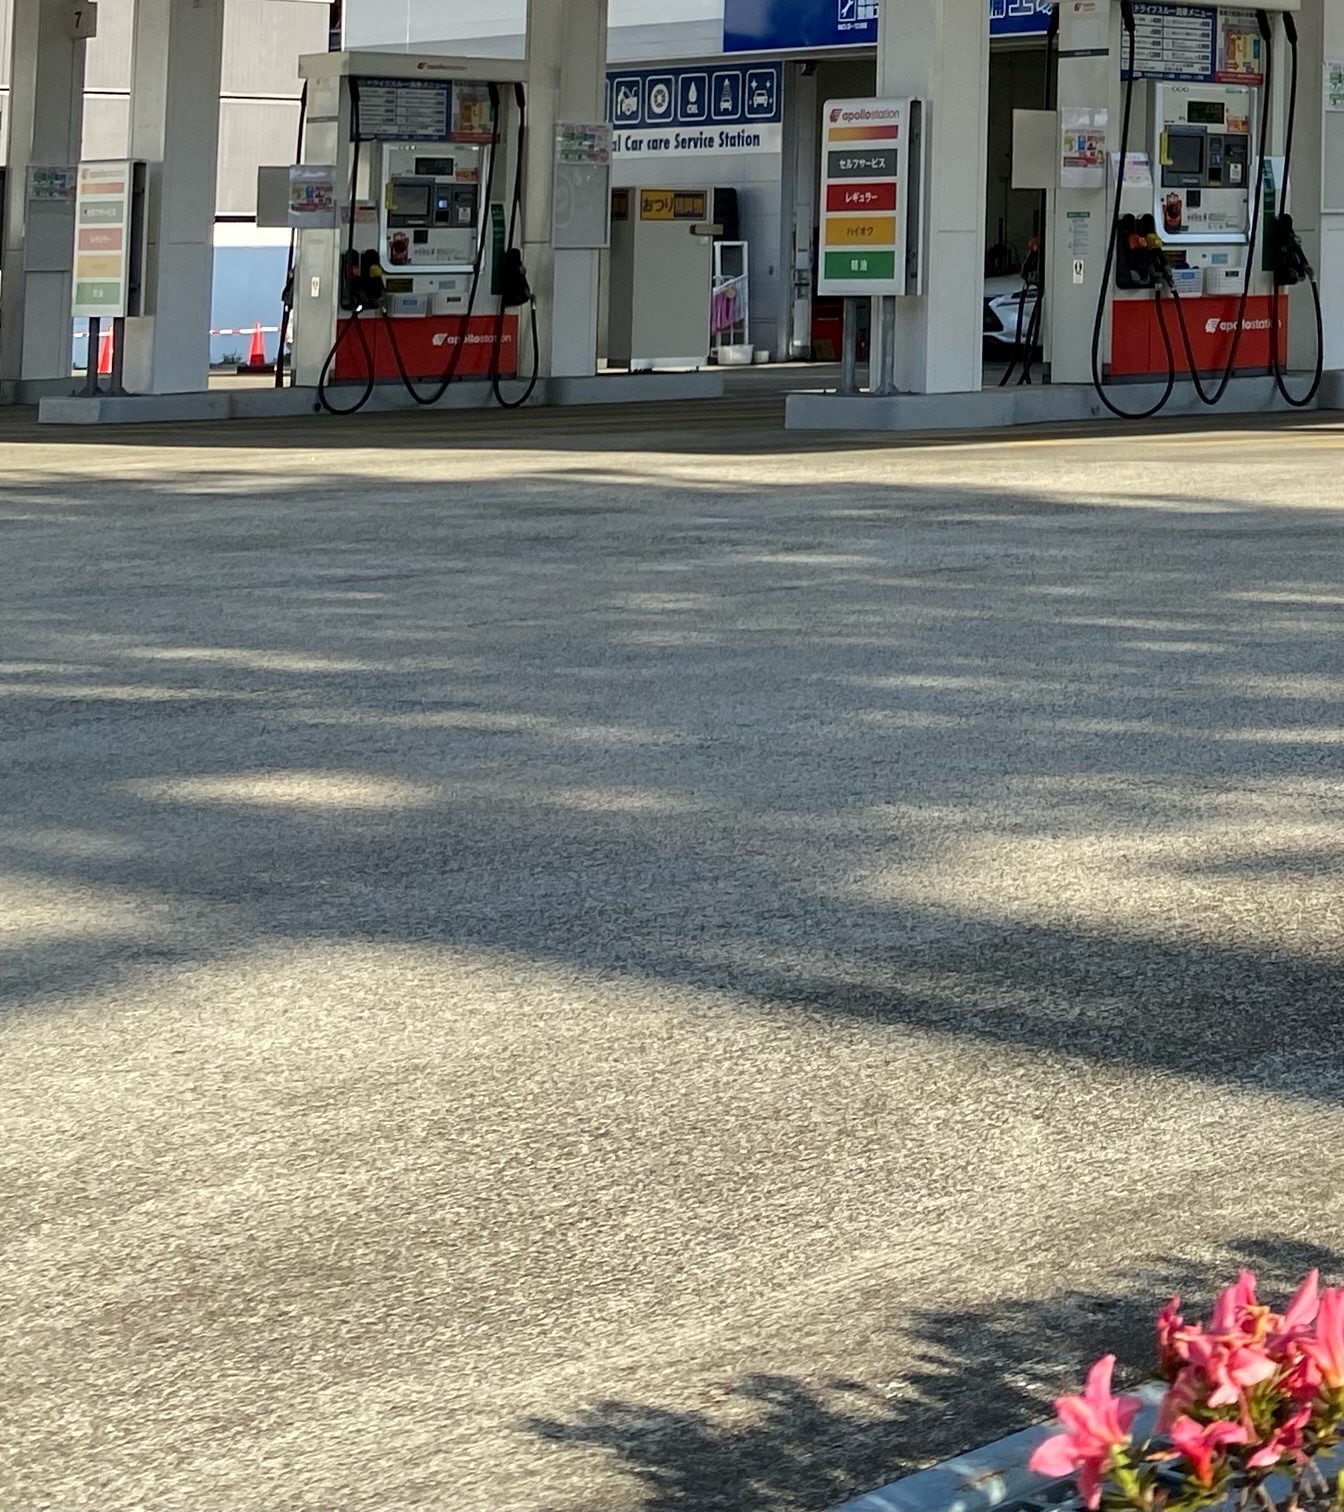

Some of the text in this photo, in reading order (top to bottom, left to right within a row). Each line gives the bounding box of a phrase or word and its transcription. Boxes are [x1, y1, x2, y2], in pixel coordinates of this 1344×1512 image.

[842, 108, 900, 123] apollostation
[625, 135, 644, 152] Car
[647, 138, 671, 150] care
[674, 131, 715, 150] Service
[718, 128, 761, 148] Station
[839, 157, 886, 170] セルフサービス
[845, 191, 879, 204] レギュラー
[642, 197, 674, 213] おつり
[846, 226, 874, 237] ハイオク
